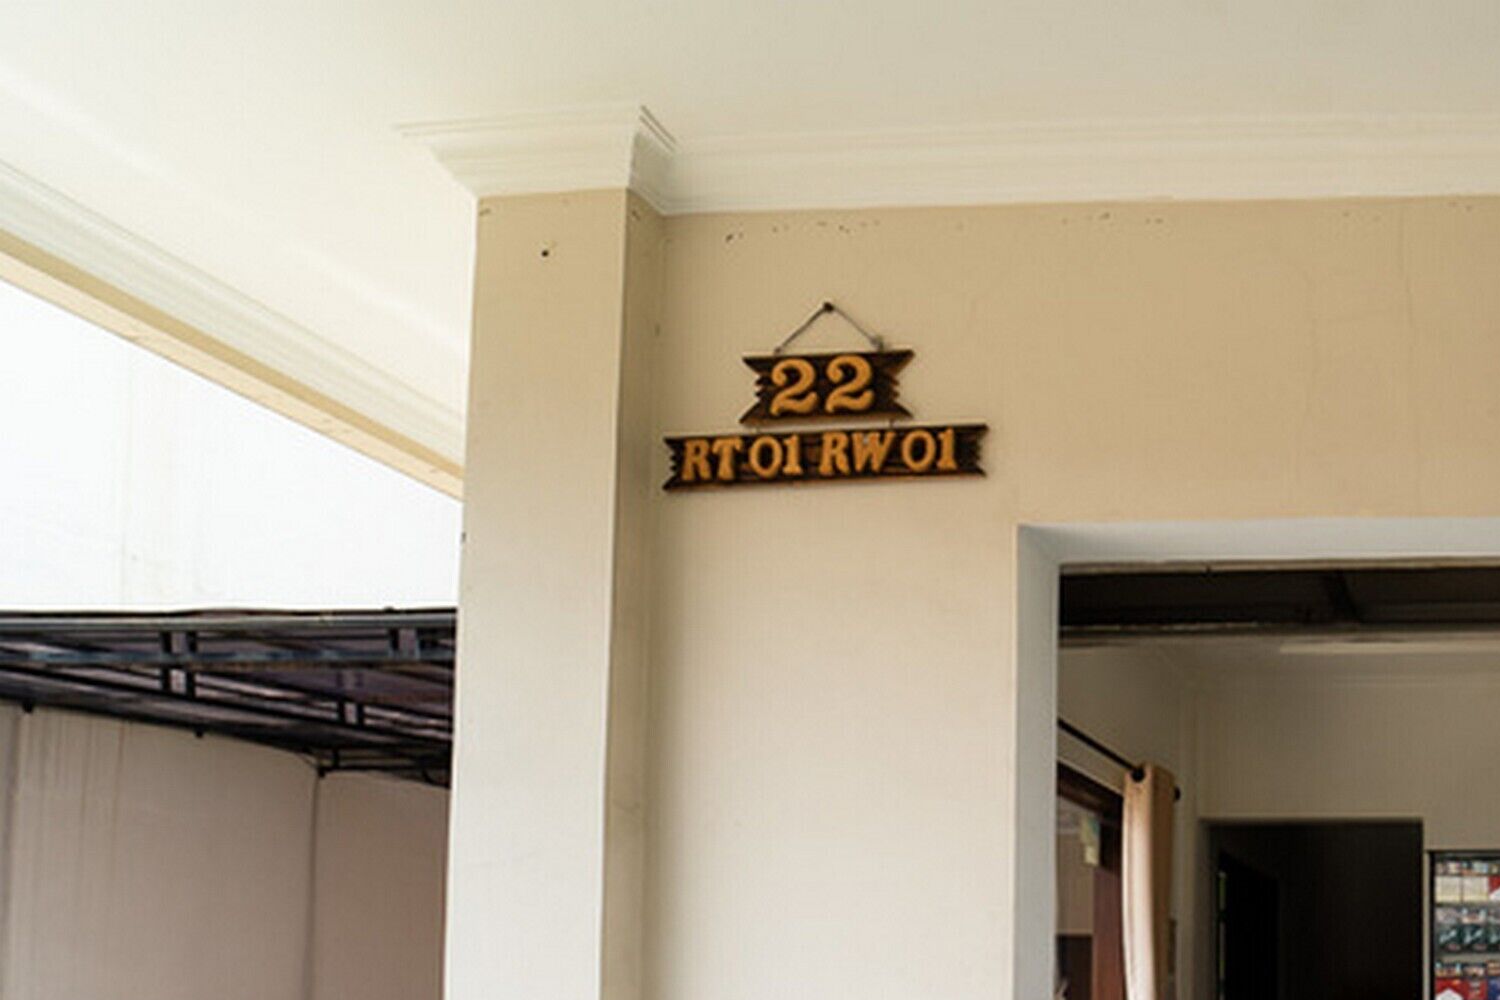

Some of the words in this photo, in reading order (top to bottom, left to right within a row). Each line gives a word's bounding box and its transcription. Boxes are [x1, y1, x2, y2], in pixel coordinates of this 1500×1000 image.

[769, 355, 874, 417] 22
[681, 437, 742, 481] RT
[749, 435, 803, 476] 01
[819, 431, 895, 475] RW
[902, 428, 958, 471] 01
